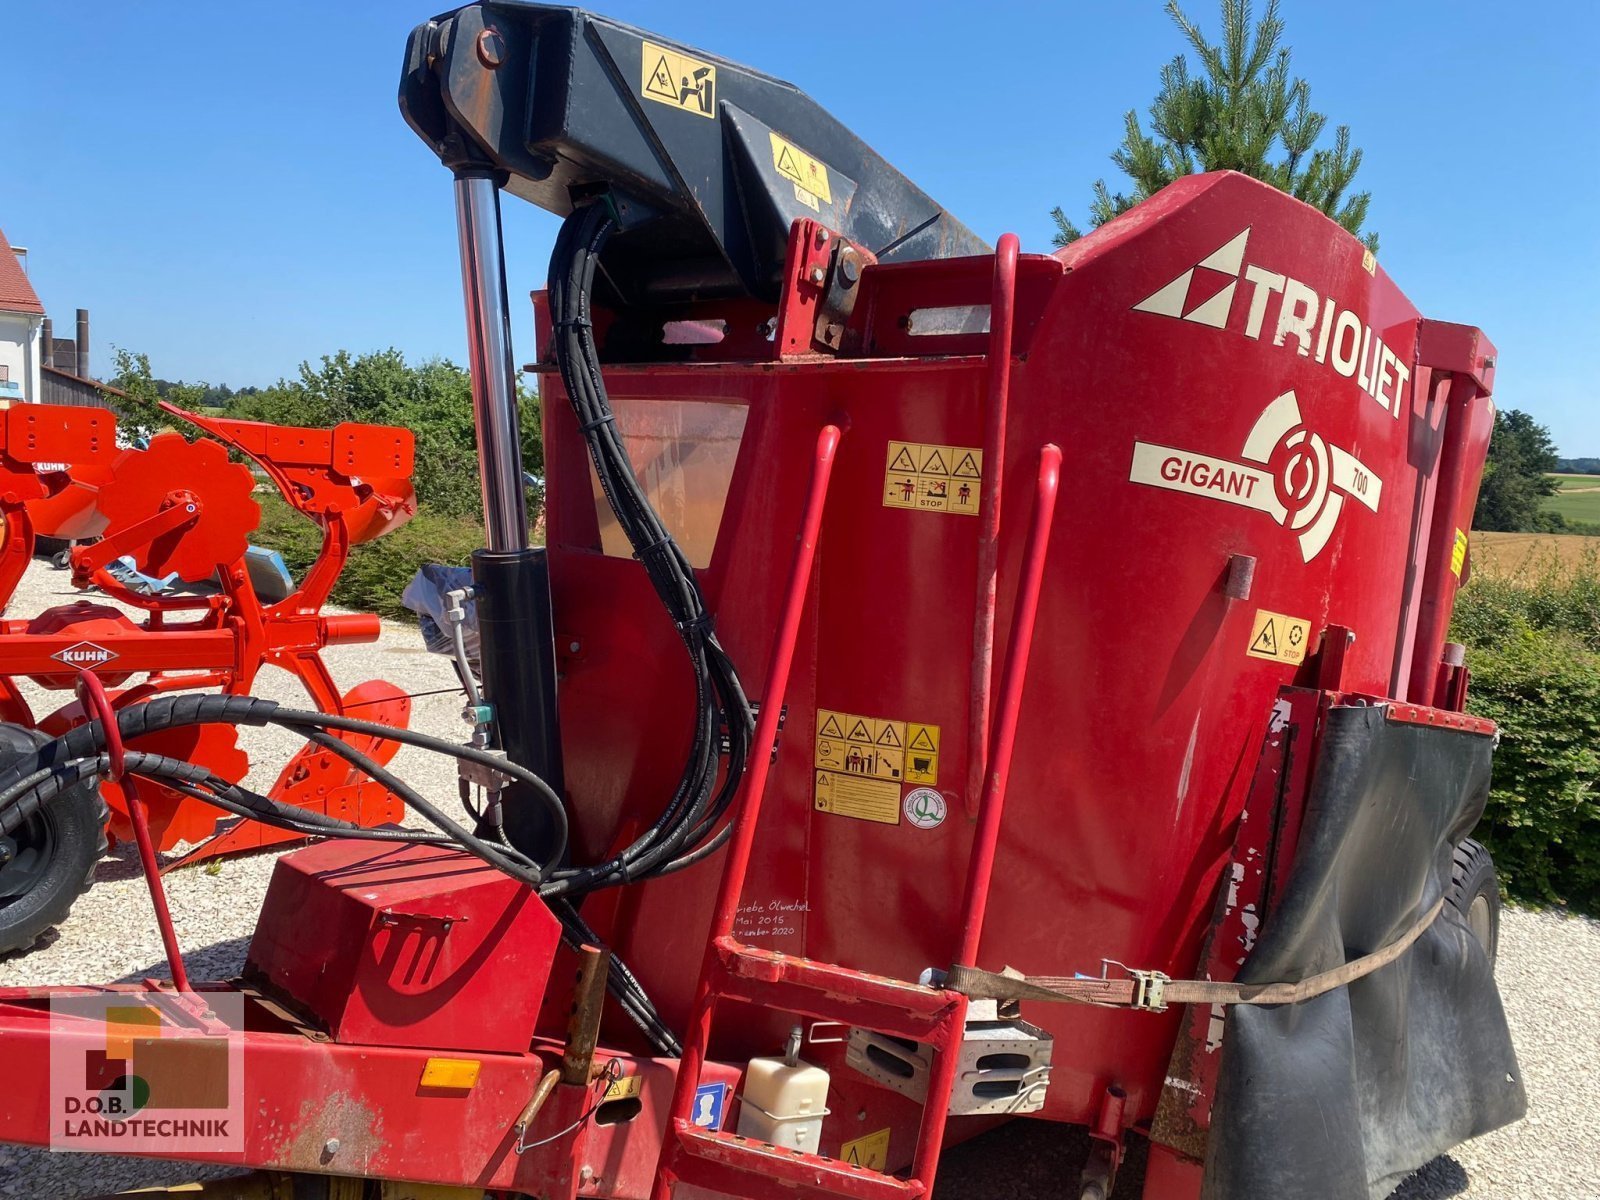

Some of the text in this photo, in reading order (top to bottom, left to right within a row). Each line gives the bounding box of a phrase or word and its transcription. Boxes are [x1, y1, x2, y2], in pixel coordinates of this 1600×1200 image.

[1244, 263, 1410, 420] TRIOLIET
[37, 462, 65, 471] KUHN
[1160, 456, 1368, 499] GIGANT 700
[920, 499, 942, 507] STOP
[63, 651, 108, 661] KUHN
[1283, 649, 1300, 659] STOP
[735, 915, 784, 925] Mai 2015
[772, 928, 795, 936] 2020
